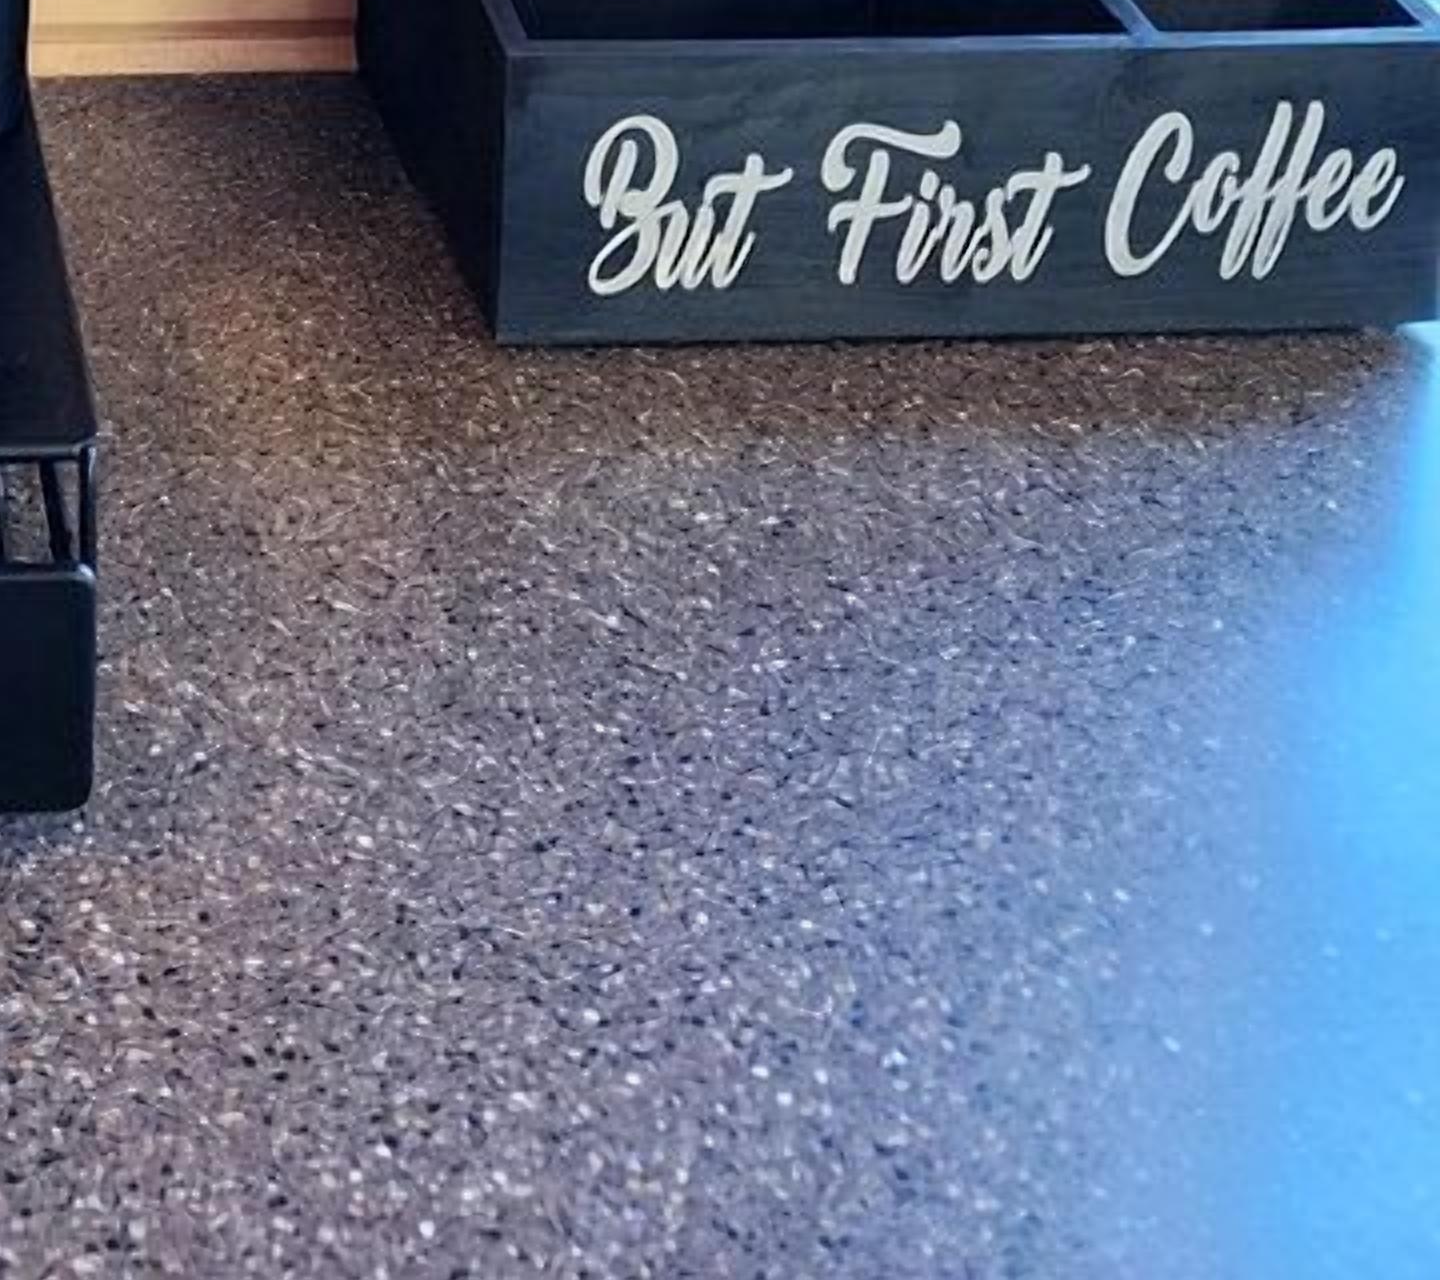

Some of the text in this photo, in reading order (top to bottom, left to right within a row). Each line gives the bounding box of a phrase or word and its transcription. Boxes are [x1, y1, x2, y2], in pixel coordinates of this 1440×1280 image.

[583, 99, 1404, 296] But First Coffee
